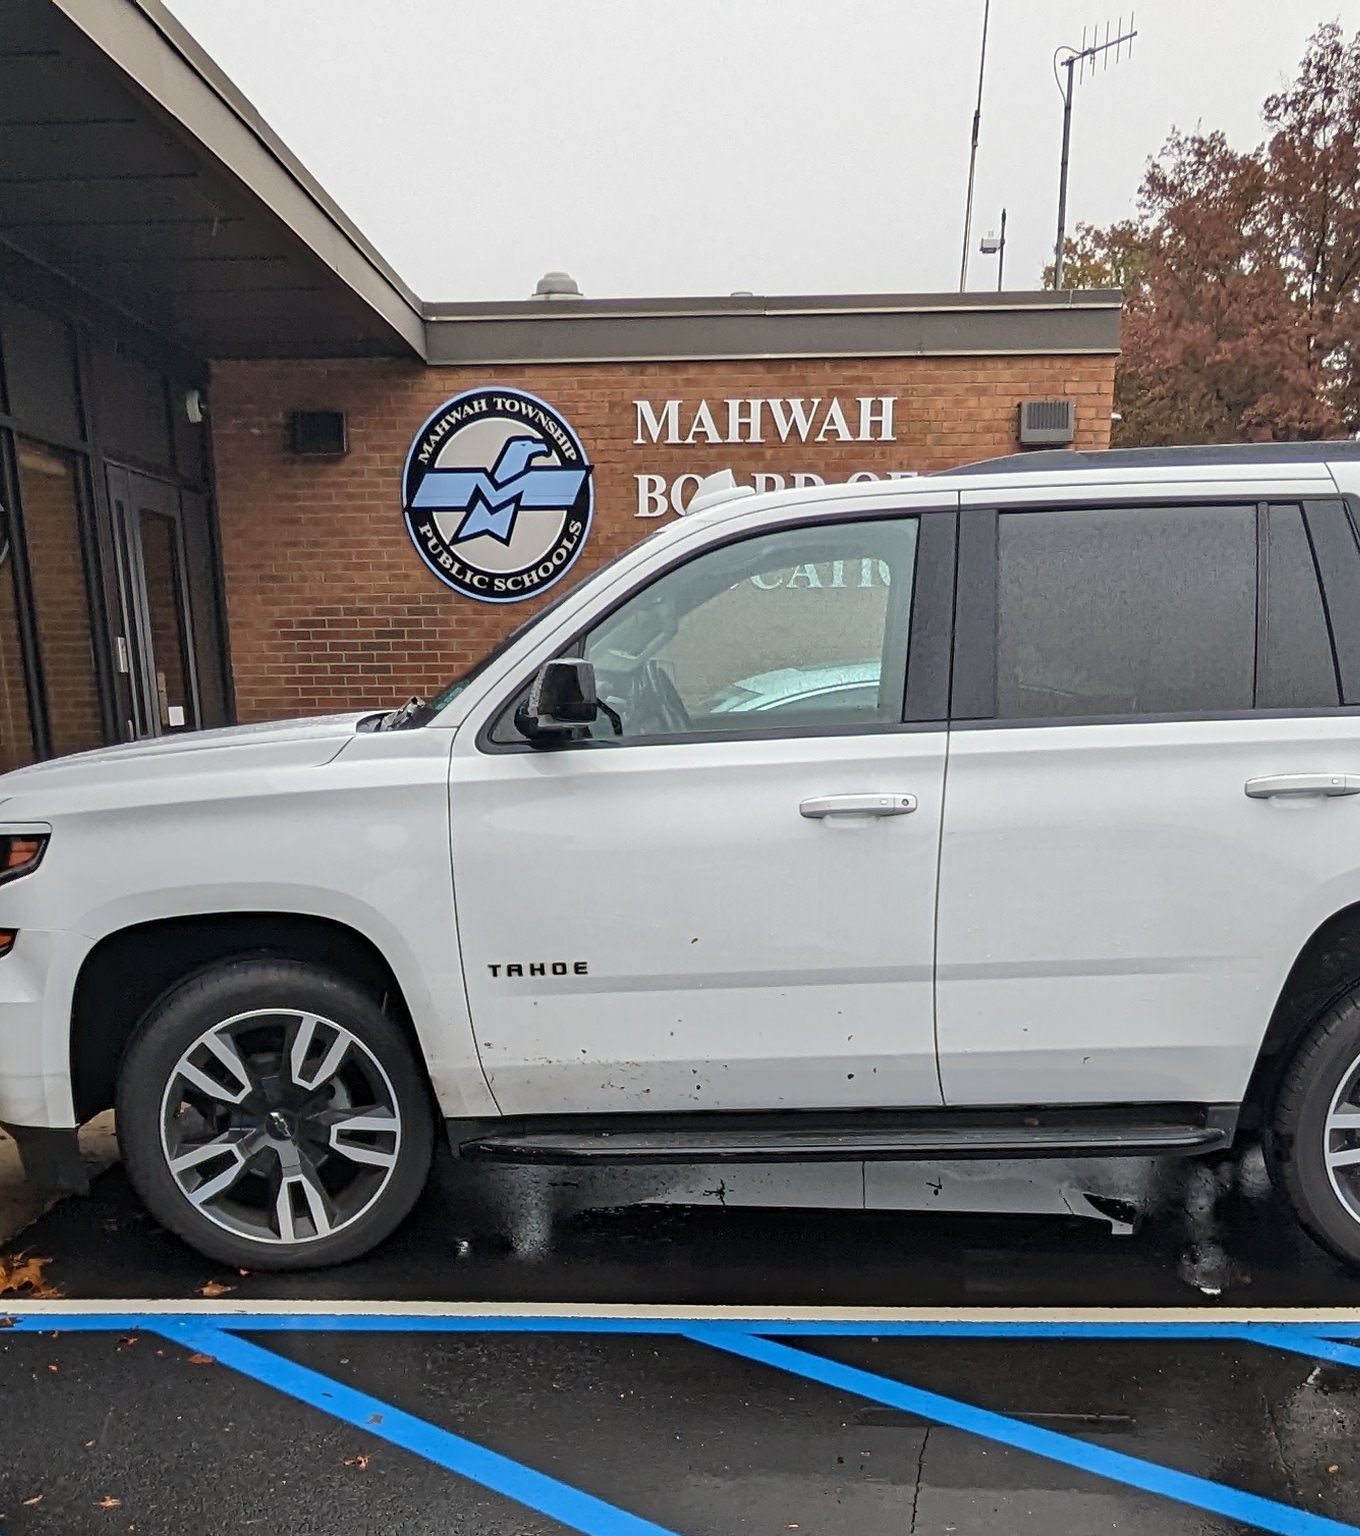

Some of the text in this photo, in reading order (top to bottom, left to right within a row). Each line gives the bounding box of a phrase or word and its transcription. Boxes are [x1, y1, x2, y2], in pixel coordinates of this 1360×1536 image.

[417, 397, 578, 465] MAHWAH TOWNSHIP
[632, 396, 898, 444] MAHWAH
[419, 519, 583, 592] PUBLIC SCHOOLS
[487, 961, 589, 978] TAHOE
